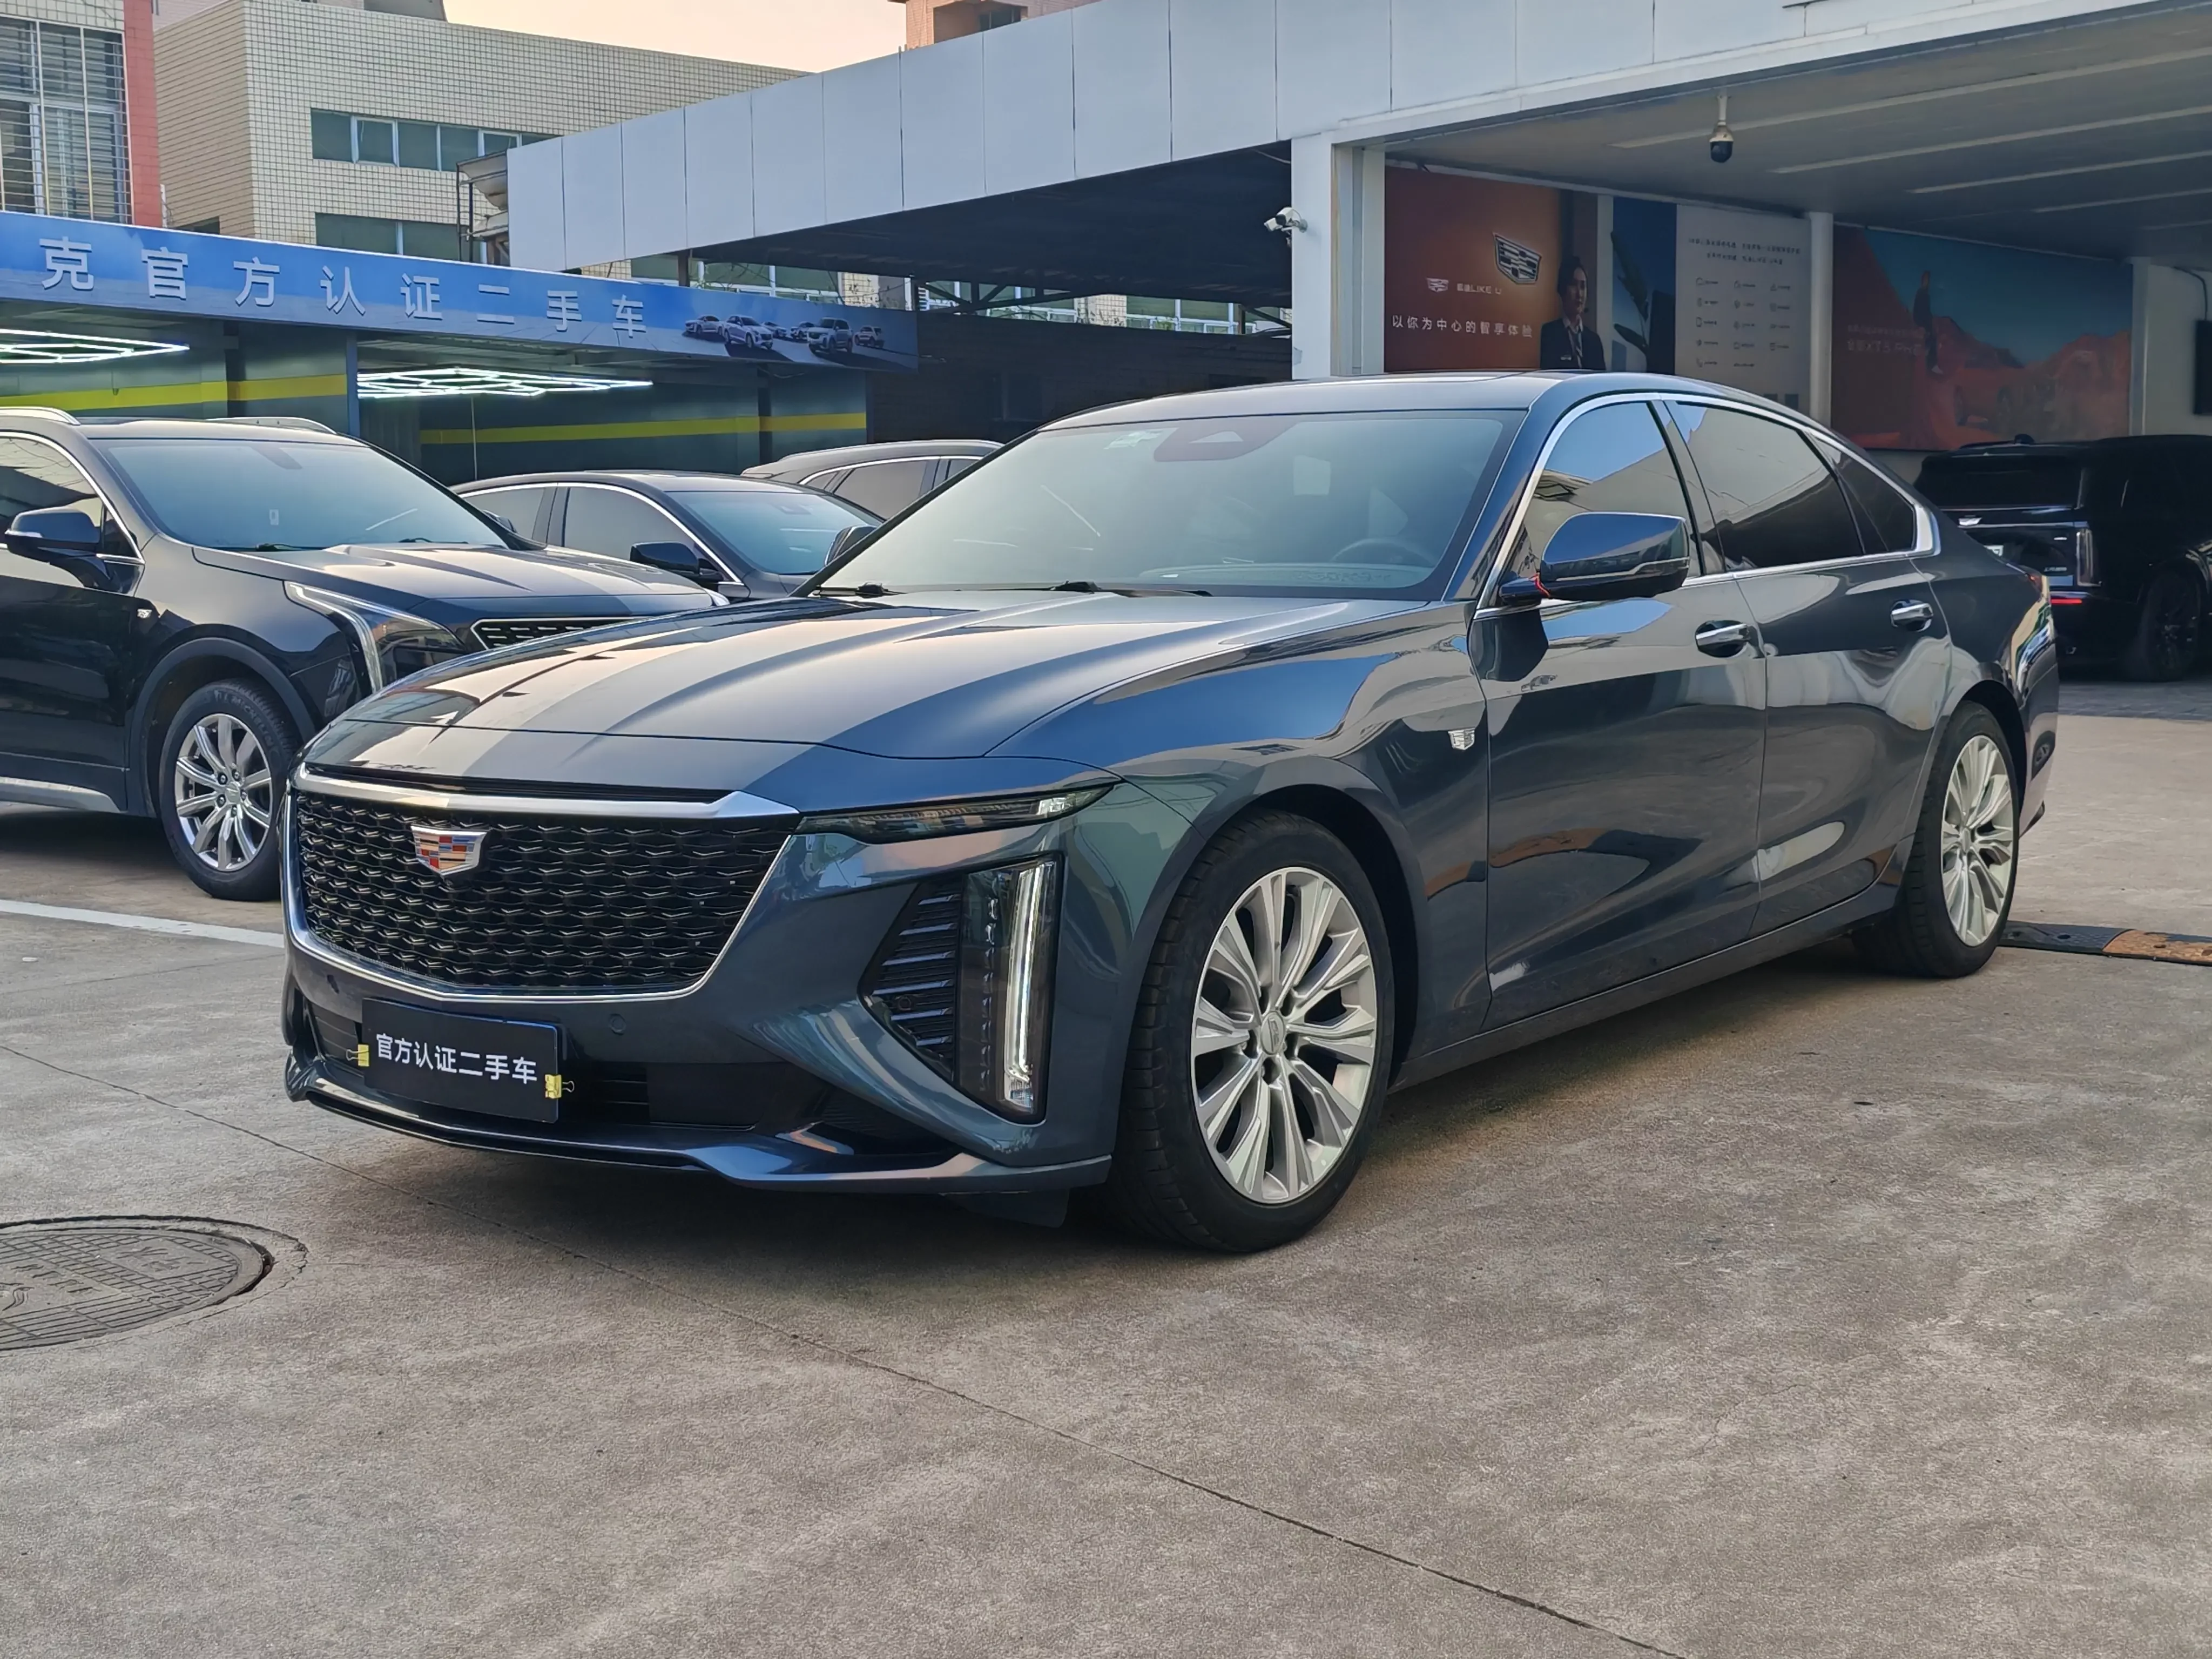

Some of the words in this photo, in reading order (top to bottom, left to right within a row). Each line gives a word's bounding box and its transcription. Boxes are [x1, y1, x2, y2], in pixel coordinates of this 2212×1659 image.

[39, 236, 646, 338] 克官方认证二手车
[376, 1033, 538, 1085] 官方认证二手车
